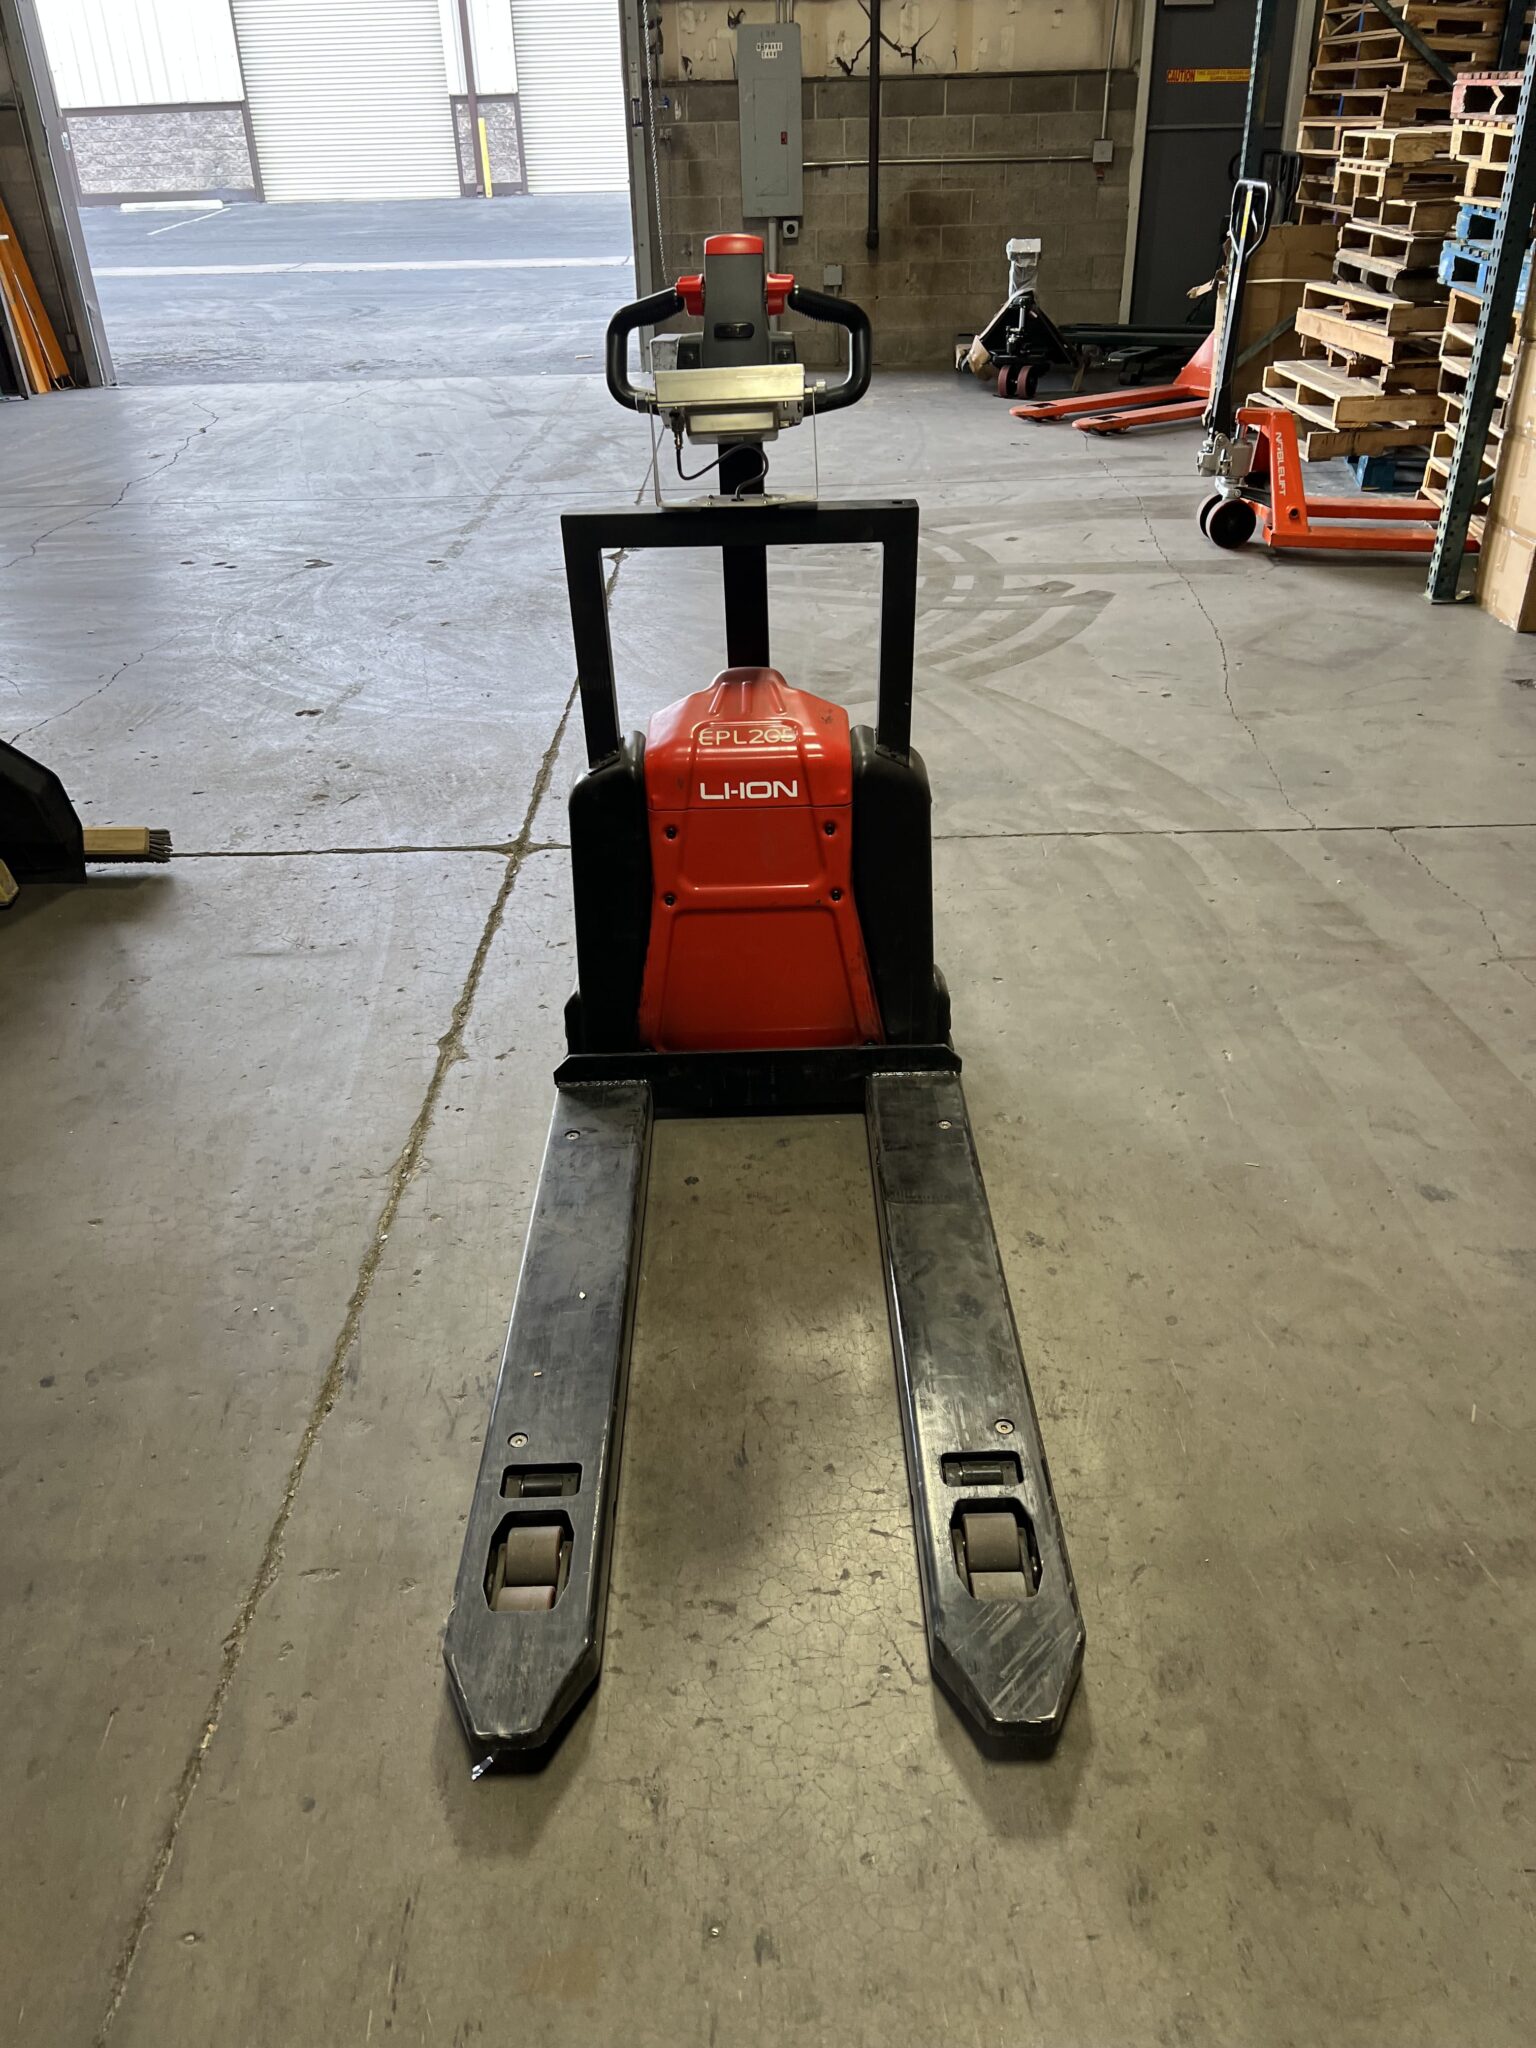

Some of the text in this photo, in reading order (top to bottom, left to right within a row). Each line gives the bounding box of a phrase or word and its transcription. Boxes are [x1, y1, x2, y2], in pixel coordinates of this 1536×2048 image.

[1167, 69, 1195, 82] CAUTION
[1275, 432, 1286, 496] NOBLELIFT
[700, 780, 798, 799] LI-ION
